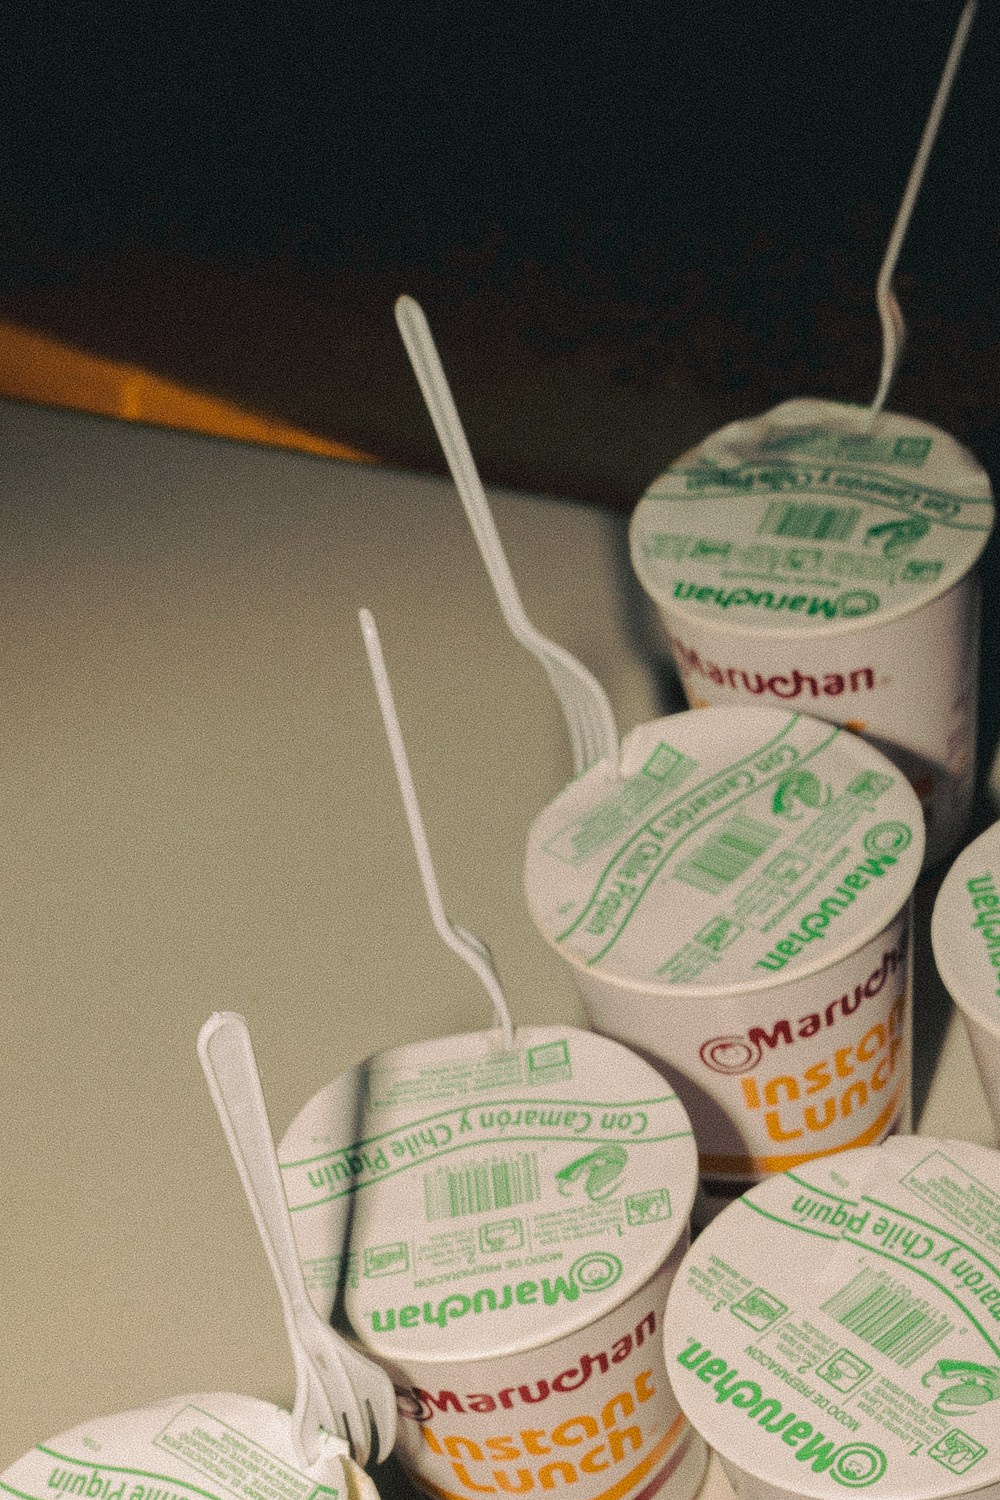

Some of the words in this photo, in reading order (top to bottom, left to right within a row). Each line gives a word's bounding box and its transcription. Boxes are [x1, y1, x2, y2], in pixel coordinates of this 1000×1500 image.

[757, 849, 899, 974] Maruchan
[872, 1220, 935, 1260] Chile
[931, 1244, 963, 1267] y
[369, 1270, 579, 1333] Maruchan
[413, 1310, 656, 1413] Maruchan
[421, 1367, 656, 1462] Instant
[676, 1342, 847, 1473] Maruchan
[451, 1425, 644, 1495] Lunch
